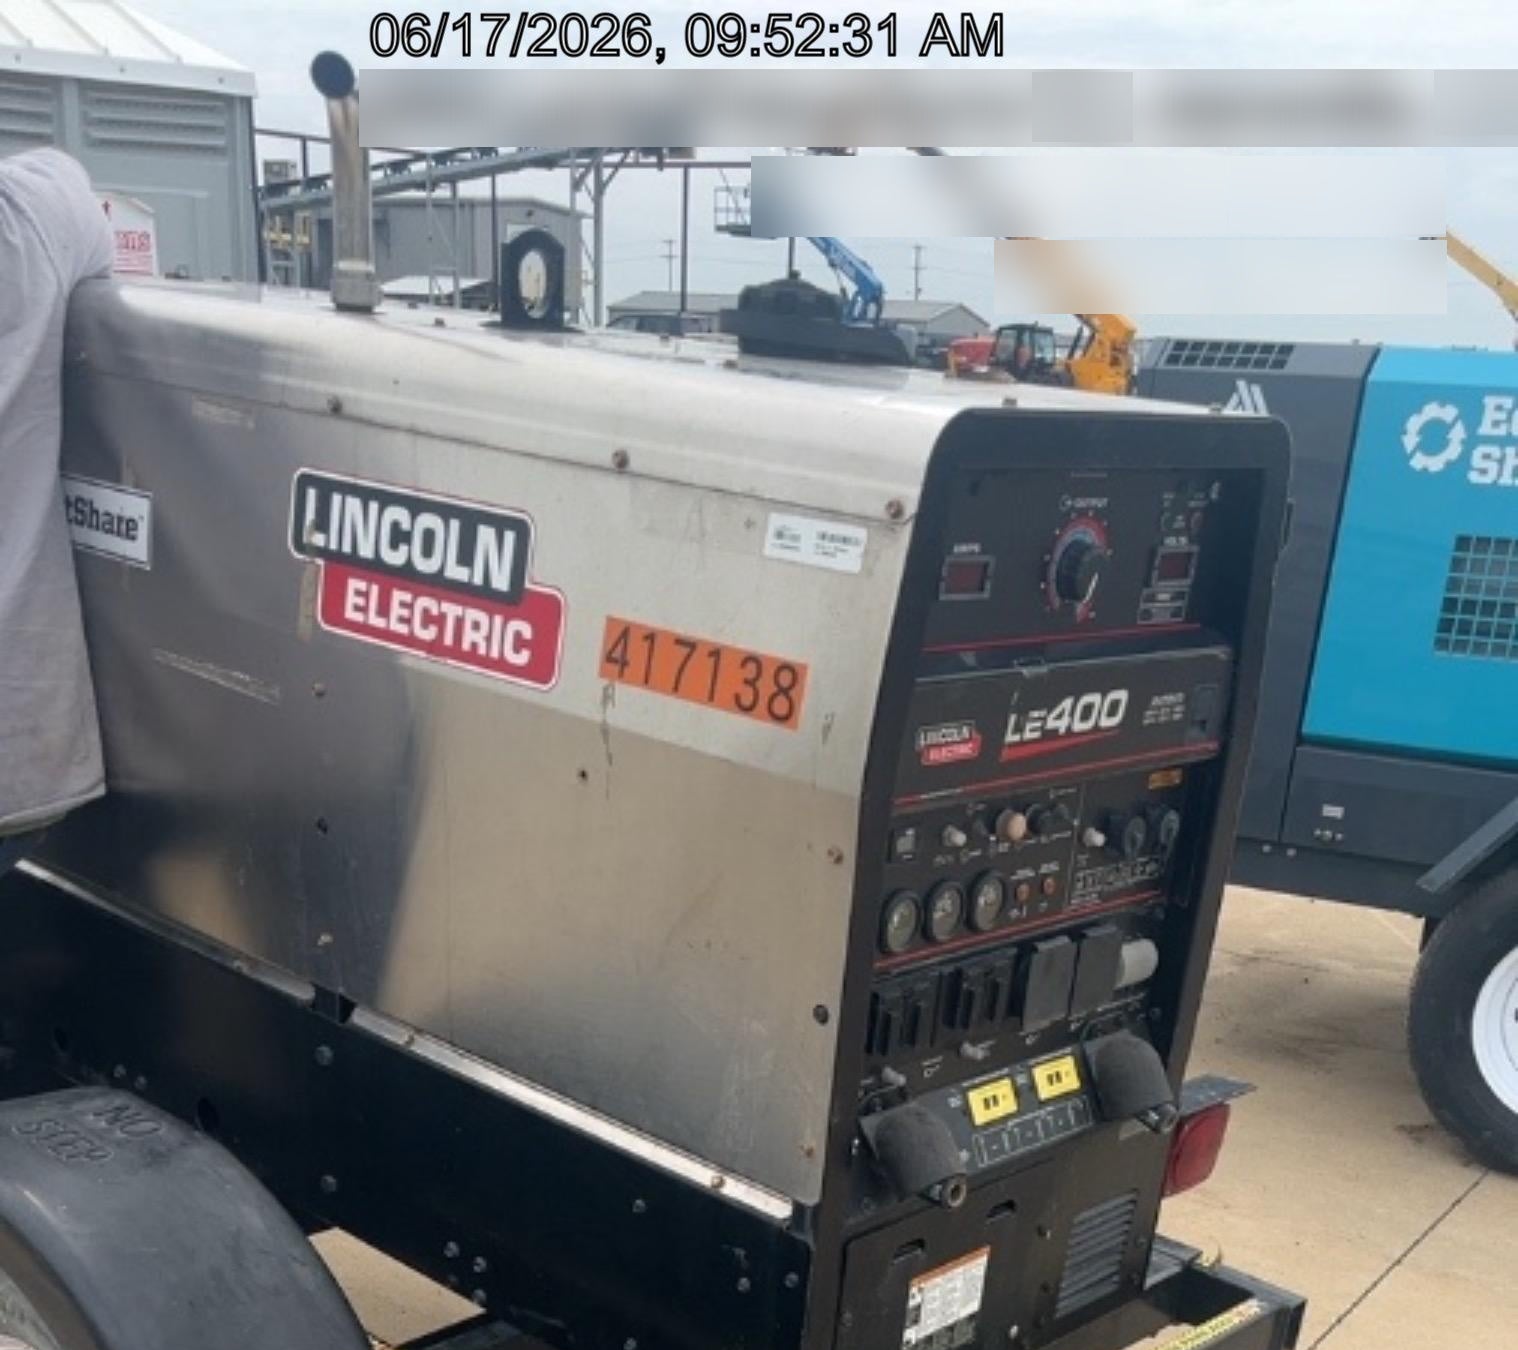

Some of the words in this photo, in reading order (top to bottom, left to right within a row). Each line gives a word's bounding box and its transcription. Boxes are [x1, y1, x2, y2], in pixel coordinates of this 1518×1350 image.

[303, 487, 516, 592] LINCOLN
[344, 578, 533, 666] ELECTRIC
[605, 625, 798, 722] 417138
[1004, 688, 1128, 744] LE400
